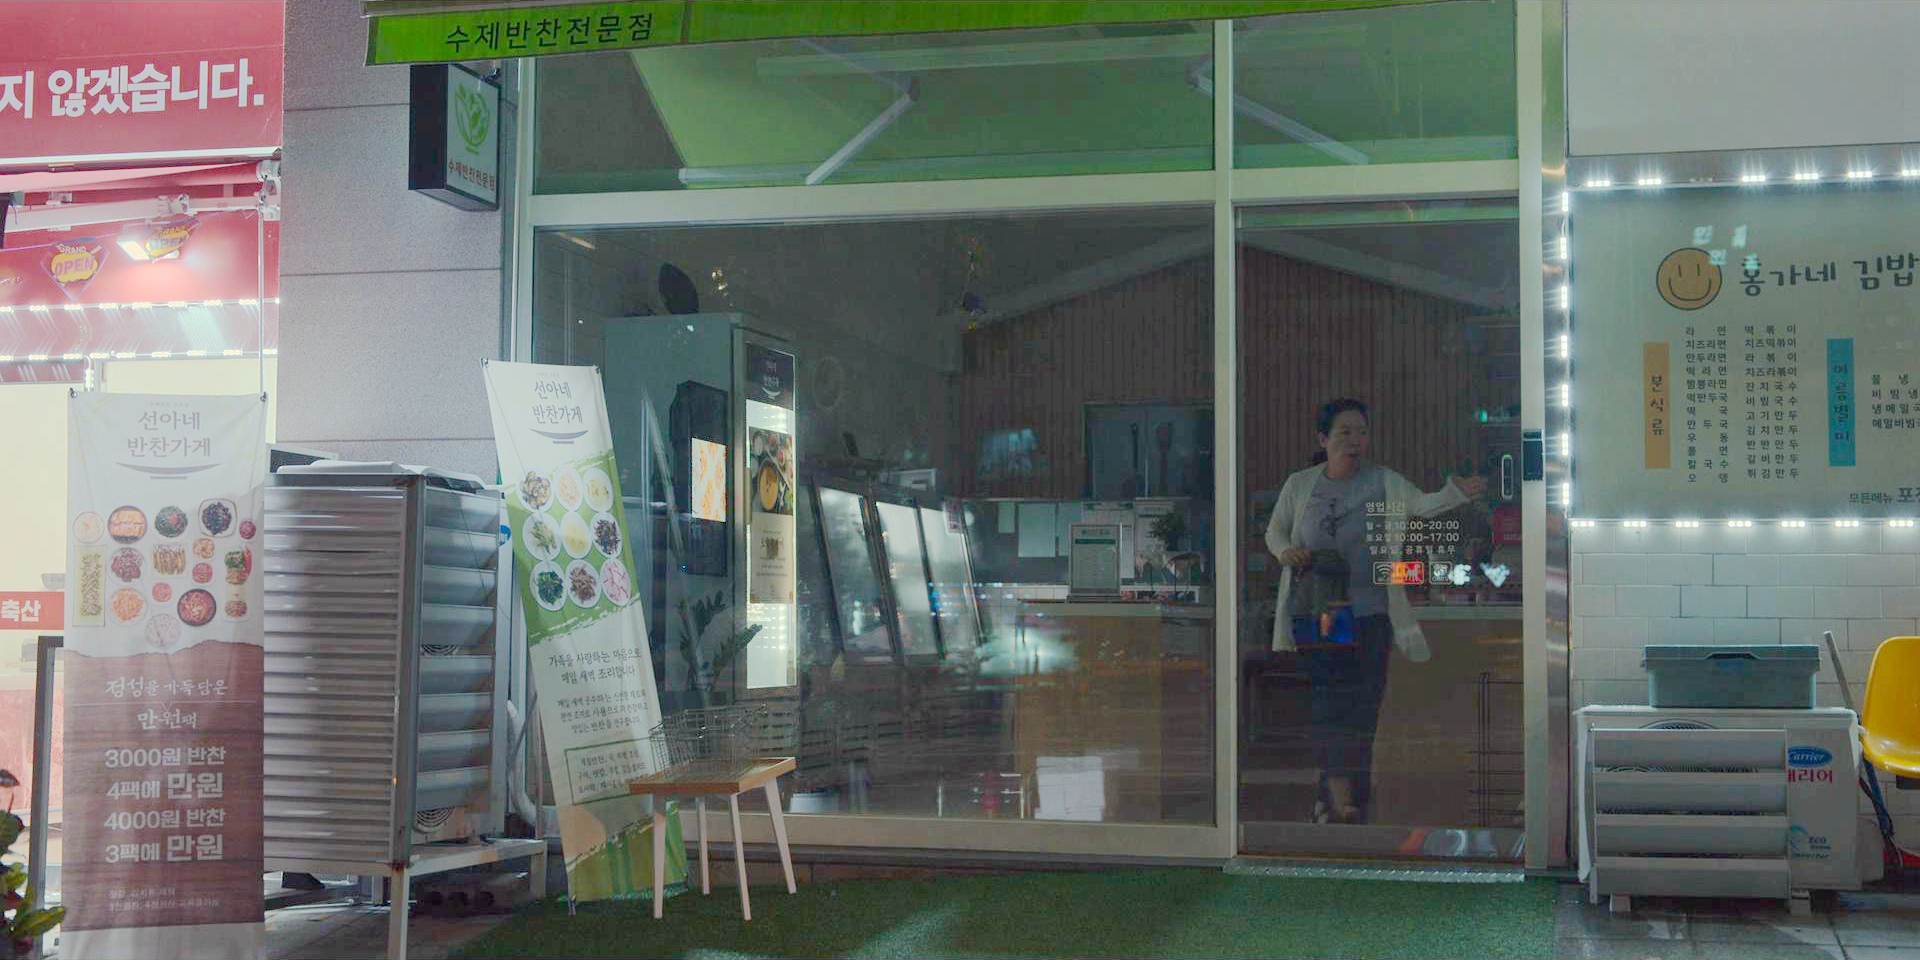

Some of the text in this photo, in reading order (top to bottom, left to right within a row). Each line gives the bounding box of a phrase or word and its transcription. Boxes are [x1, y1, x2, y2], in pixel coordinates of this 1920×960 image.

[445, 13, 653, 52] 수제반찬전문점
[0, 58, 264, 118] 지 않겠습니다.
[57, 243, 87, 253] GRAND
[54, 258, 94, 276] OPEN
[1853, 252, 1920, 290] 김밥
[534, 380, 572, 399] 선아네
[138, 410, 201, 431] 선아네
[532, 404, 583, 424] 반찬가게
[127, 436, 211, 458] 반찬가게
[0, 599, 41, 622] 축산
[576, 651, 610, 666] 사랑하는
[598, 665, 636, 680] 조리합니다
[104, 676, 160, 699] 정성을
[137, 708, 198, 731] 만원팩
[104, 746, 226, 768] 3000원 반찬
[106, 772, 224, 800] 4팩에 만원
[103, 808, 226, 830] 4000원 반찬
[104, 835, 224, 863] 3팩에 만원
